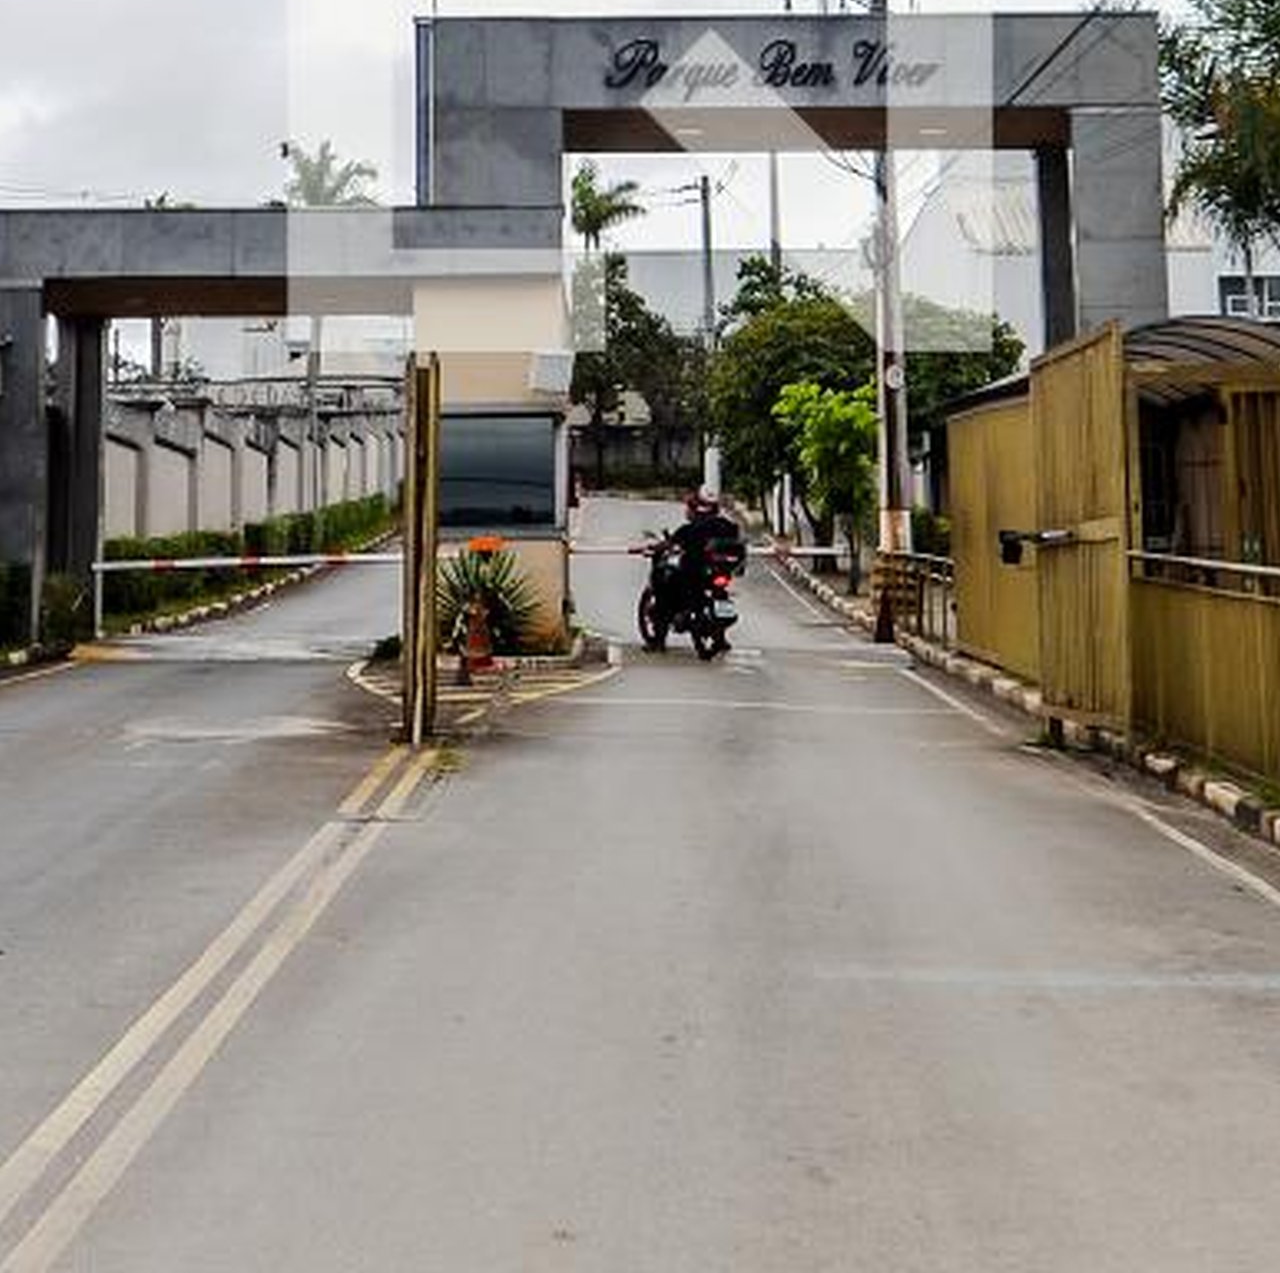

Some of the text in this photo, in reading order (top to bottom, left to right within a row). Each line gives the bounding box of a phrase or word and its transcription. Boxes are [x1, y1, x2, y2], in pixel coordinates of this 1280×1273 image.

[605, 38, 941, 102] Parque Bem Viver
